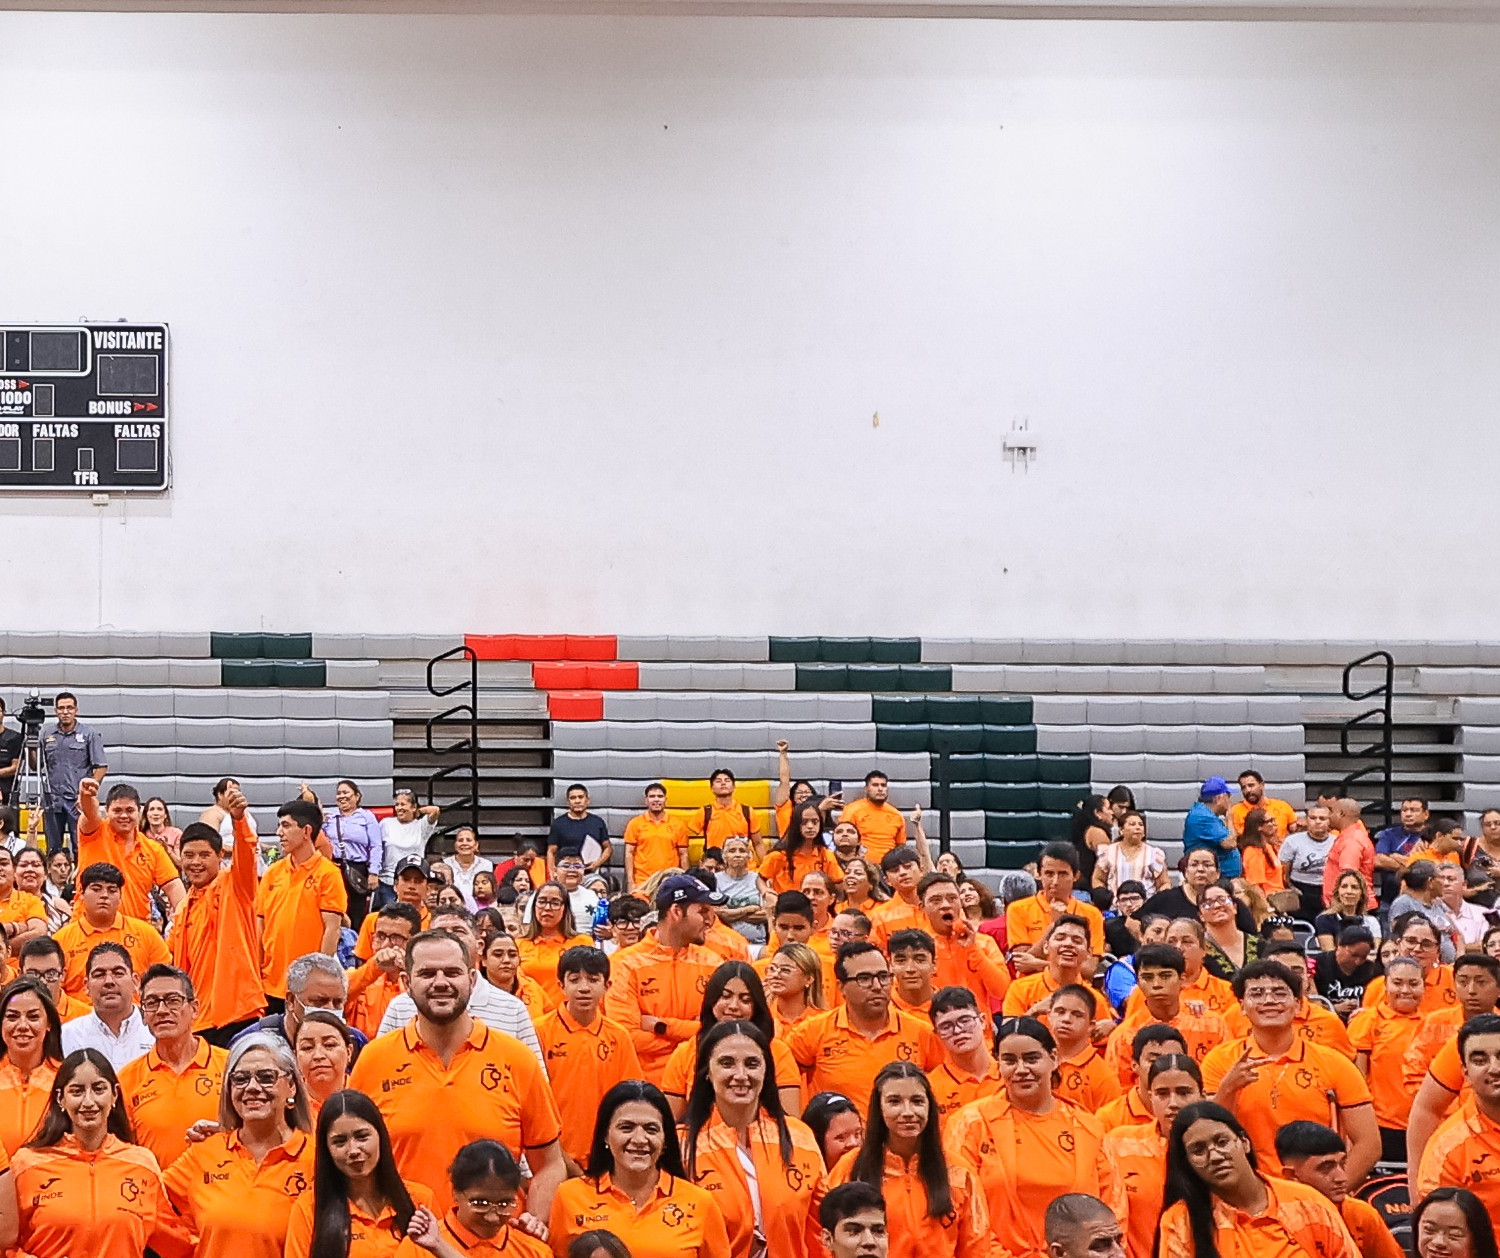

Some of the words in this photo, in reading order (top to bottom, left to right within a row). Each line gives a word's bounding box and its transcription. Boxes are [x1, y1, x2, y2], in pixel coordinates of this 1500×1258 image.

[94, 332, 162, 350] VISITANTE
[89, 401, 131, 414] BONUS
[32, 424, 79, 438] FALTAS
[114, 425, 160, 438] FALTAS
[73, 471, 99, 485] TFR
[390, 1078, 412, 1087] INDE
[41, 1191, 63, 1200] INDE
